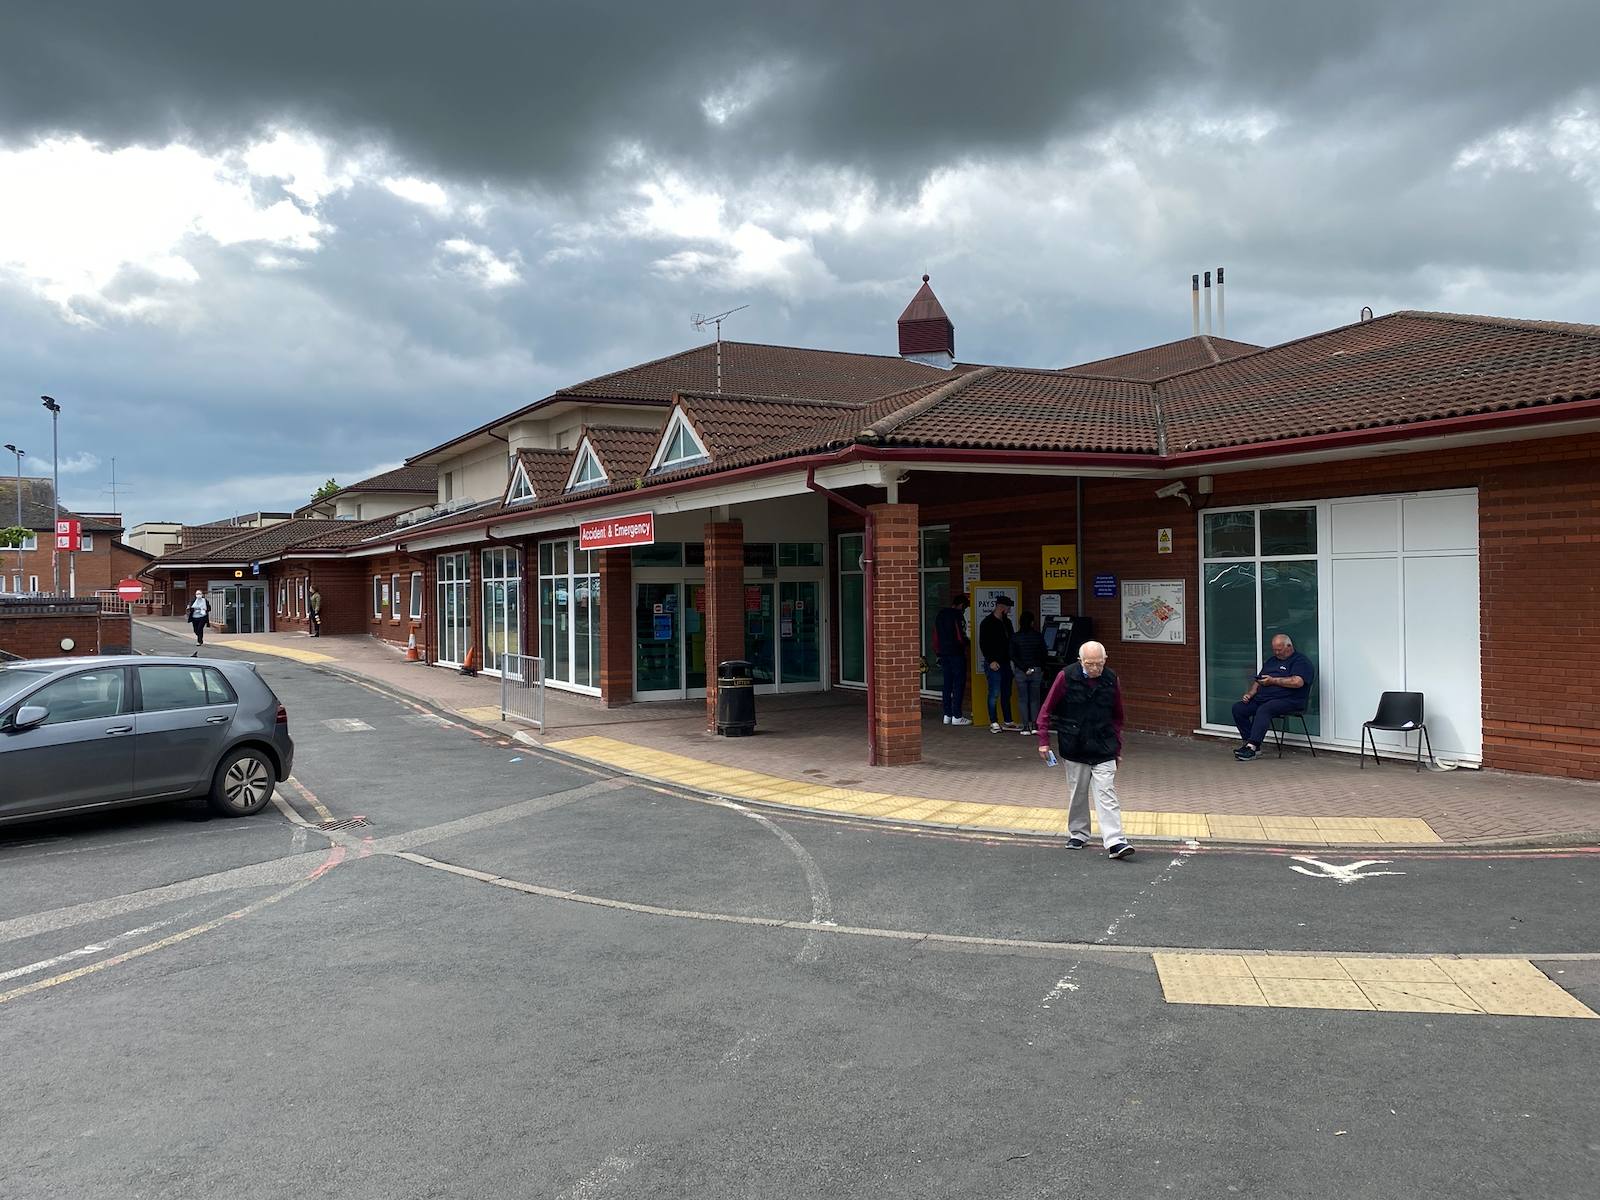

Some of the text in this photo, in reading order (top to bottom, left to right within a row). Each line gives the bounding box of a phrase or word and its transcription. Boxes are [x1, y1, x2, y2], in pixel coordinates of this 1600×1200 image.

[582, 522, 650, 540] Accident & Emergency
[1049, 557, 1069, 565] PAY
[1045, 569, 1075, 578] HERE
